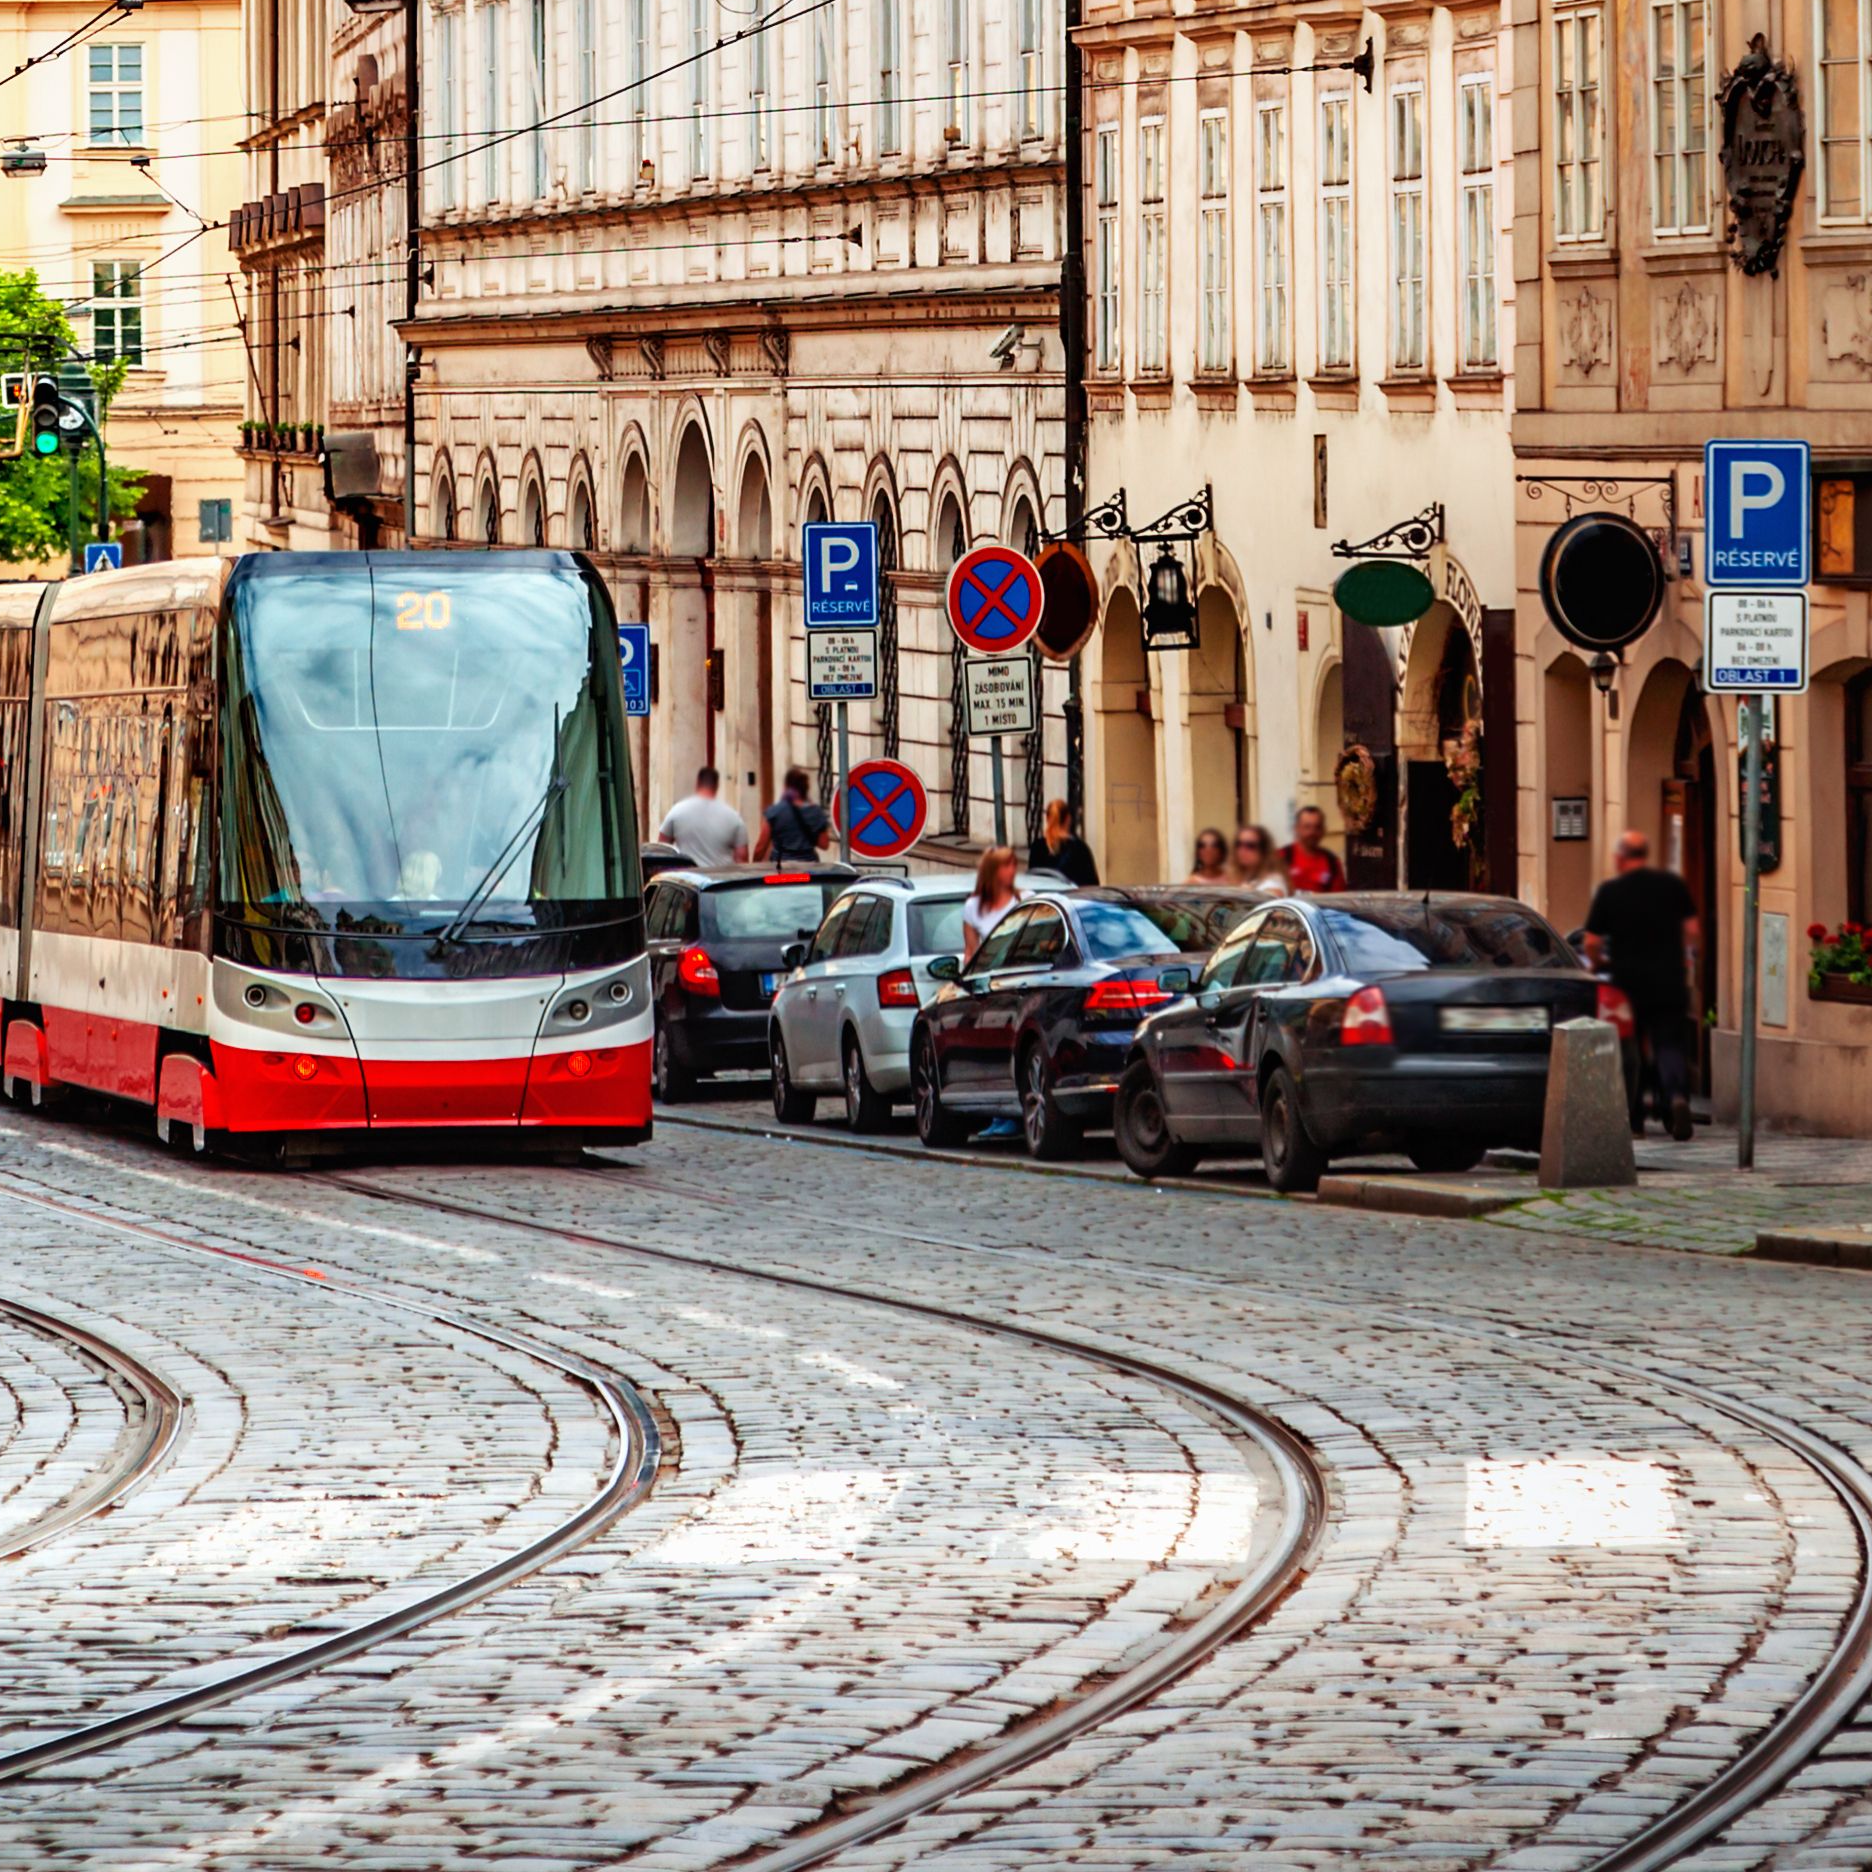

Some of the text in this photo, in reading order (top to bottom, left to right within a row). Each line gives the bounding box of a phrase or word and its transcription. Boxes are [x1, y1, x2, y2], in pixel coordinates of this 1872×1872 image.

[1730, 460, 1785, 539] P
[1715, 547, 1800, 568] RÉSERVÉ
[821, 537, 860, 593] P
[396, 591, 451, 630] 20
[812, 599, 871, 613] RÉSERVÉ
[1736, 614, 1777, 623] S PLATNOU
[1764, 627, 1793, 637] KARTOU
[832, 646, 859, 654] PLATNOU
[988, 666, 1009, 677] MIMO
[1718, 670, 1785, 682] OBLAST 1
[821, 684, 866, 694] OBLAST 1
[975, 678, 1024, 694] ZÁSOBOVÁNÍ
[996, 698, 1006, 709] 15
[1008, 698, 1027, 707] MIN.
[984, 712, 1017, 726] 1 MÍSTO
